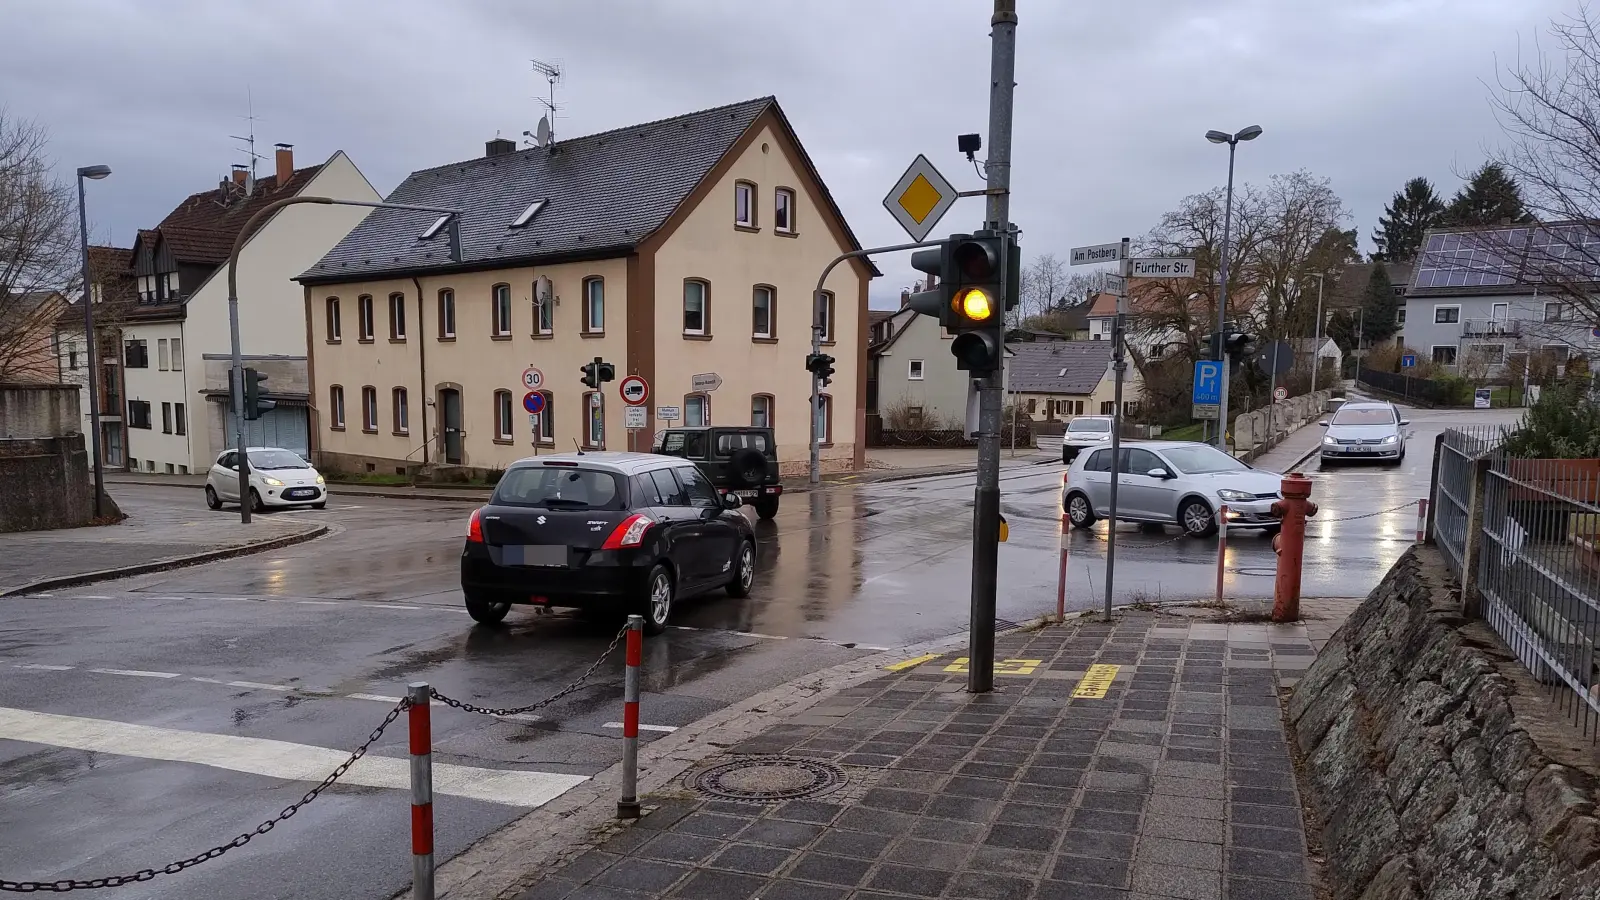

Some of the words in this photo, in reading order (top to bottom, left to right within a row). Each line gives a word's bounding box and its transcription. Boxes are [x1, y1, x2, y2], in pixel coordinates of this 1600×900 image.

[1074, 251, 1085, 261] Am
[1087, 248, 1117, 259] Postberg
[1134, 262, 1171, 274] Fürther
[1173, 261, 1190, 273] Str.
[526, 373, 540, 384] 30
[1199, 364, 1217, 387] P
